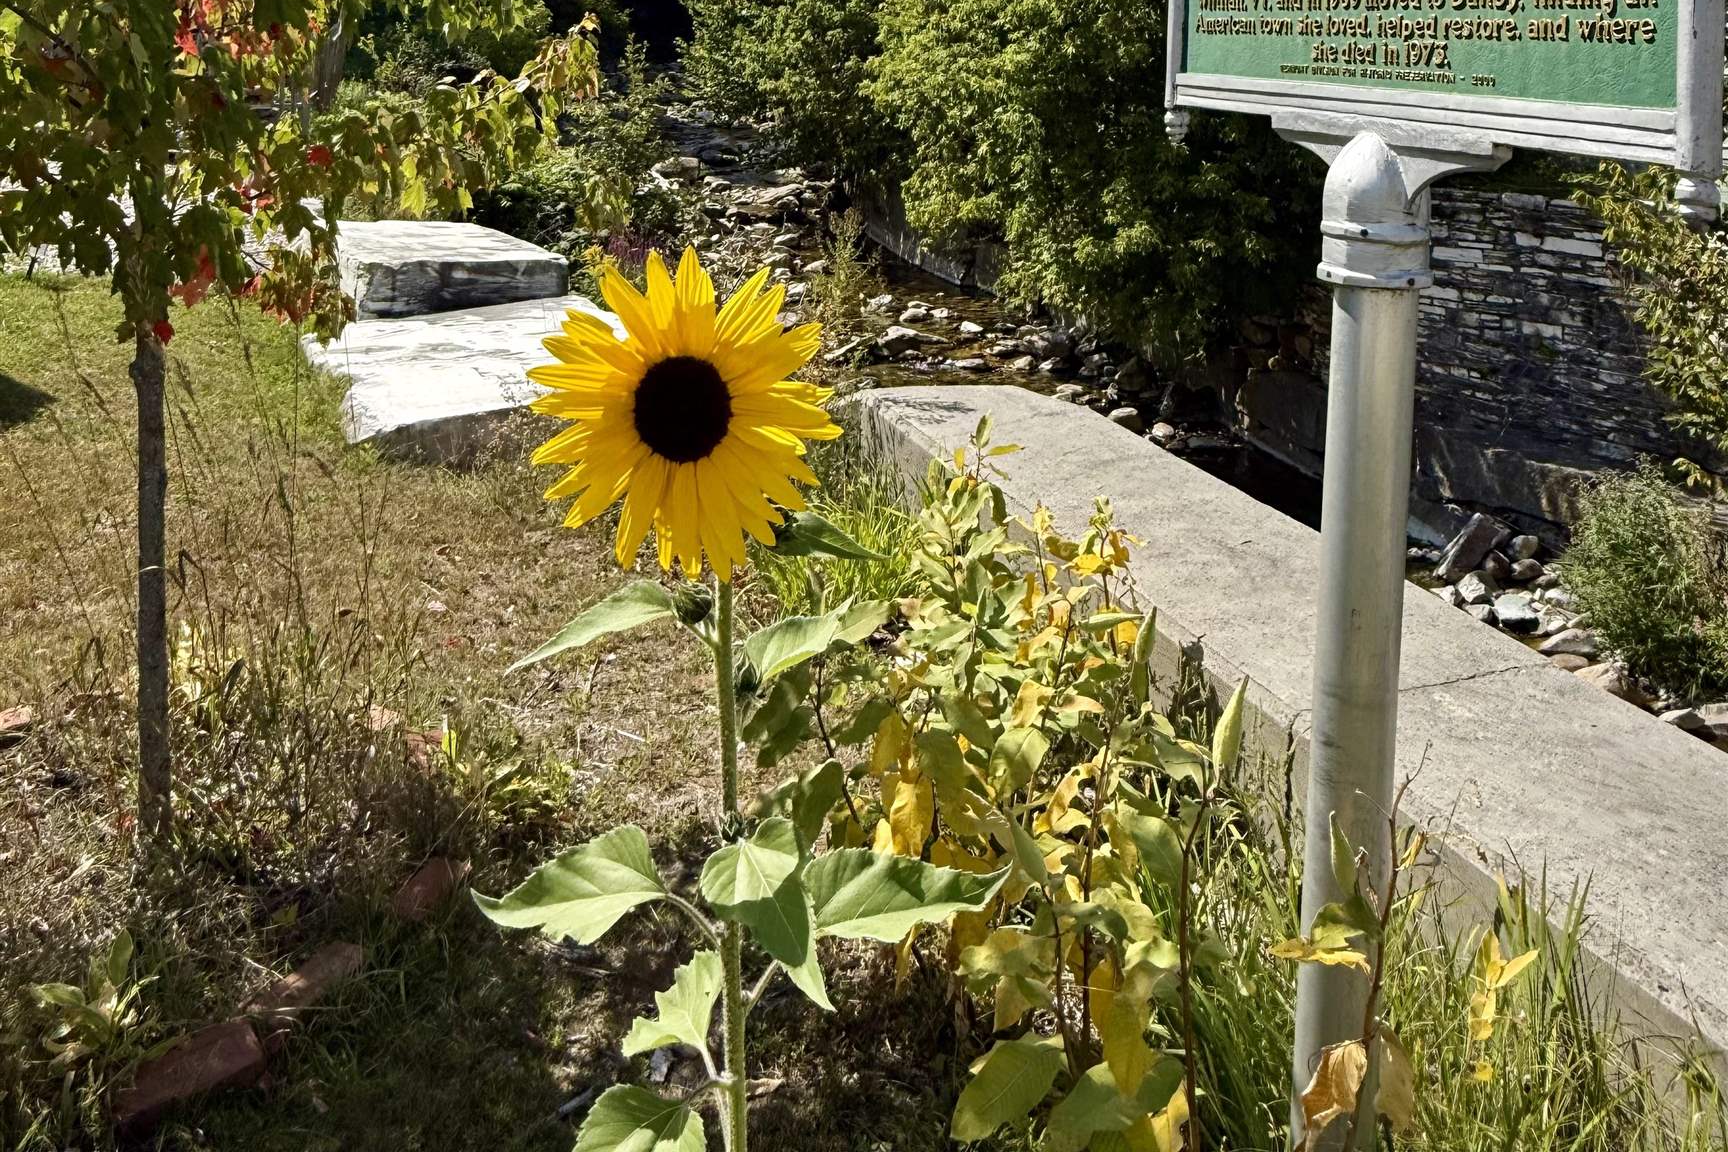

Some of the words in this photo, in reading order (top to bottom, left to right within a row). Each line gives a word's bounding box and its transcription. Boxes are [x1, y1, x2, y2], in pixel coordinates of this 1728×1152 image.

[1198, 16, 1257, 35] American
[1259, 16, 1292, 34] town
[1297, 16, 1324, 36] she
[1325, 14, 1371, 37] loved,
[1376, 13, 1438, 43] helped
[1442, 18, 1522, 39] restore,
[1527, 14, 1569, 40] and
[1576, 12, 1655, 42] where
[1311, 43, 1339, 63] she
[1342, 42, 1376, 64] died
[1381, 43, 1399, 65] in
[1404, 40, 1448, 67] 1973.
